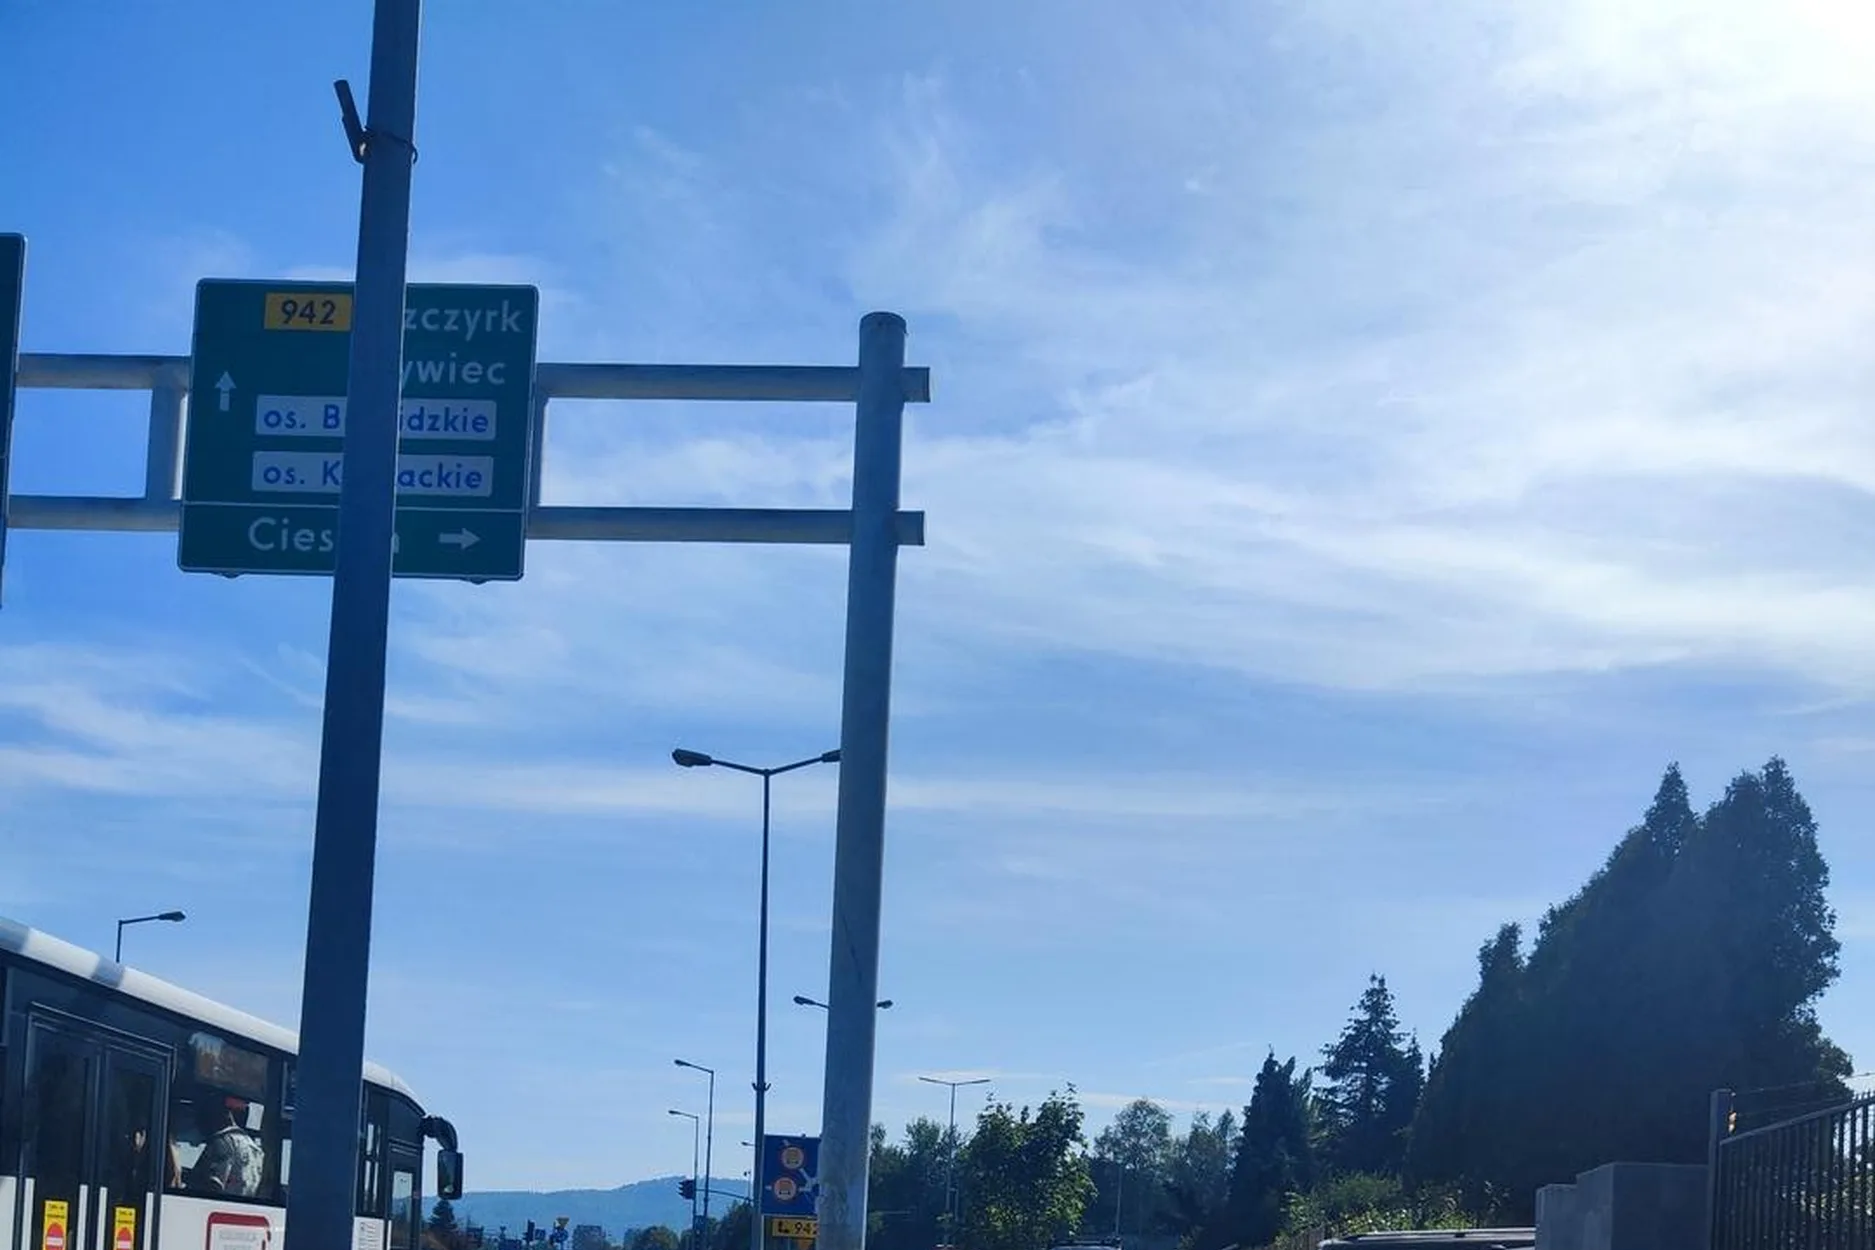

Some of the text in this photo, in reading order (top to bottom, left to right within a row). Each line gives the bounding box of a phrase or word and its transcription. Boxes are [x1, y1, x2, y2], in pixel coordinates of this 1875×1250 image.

[281, 300, 336, 325] 942
[403, 300, 523, 341] zczyrk
[402, 352, 507, 390] ywiec
[263, 404, 490, 434] os. Bidzkie
[262, 460, 483, 490] os. Kackie
